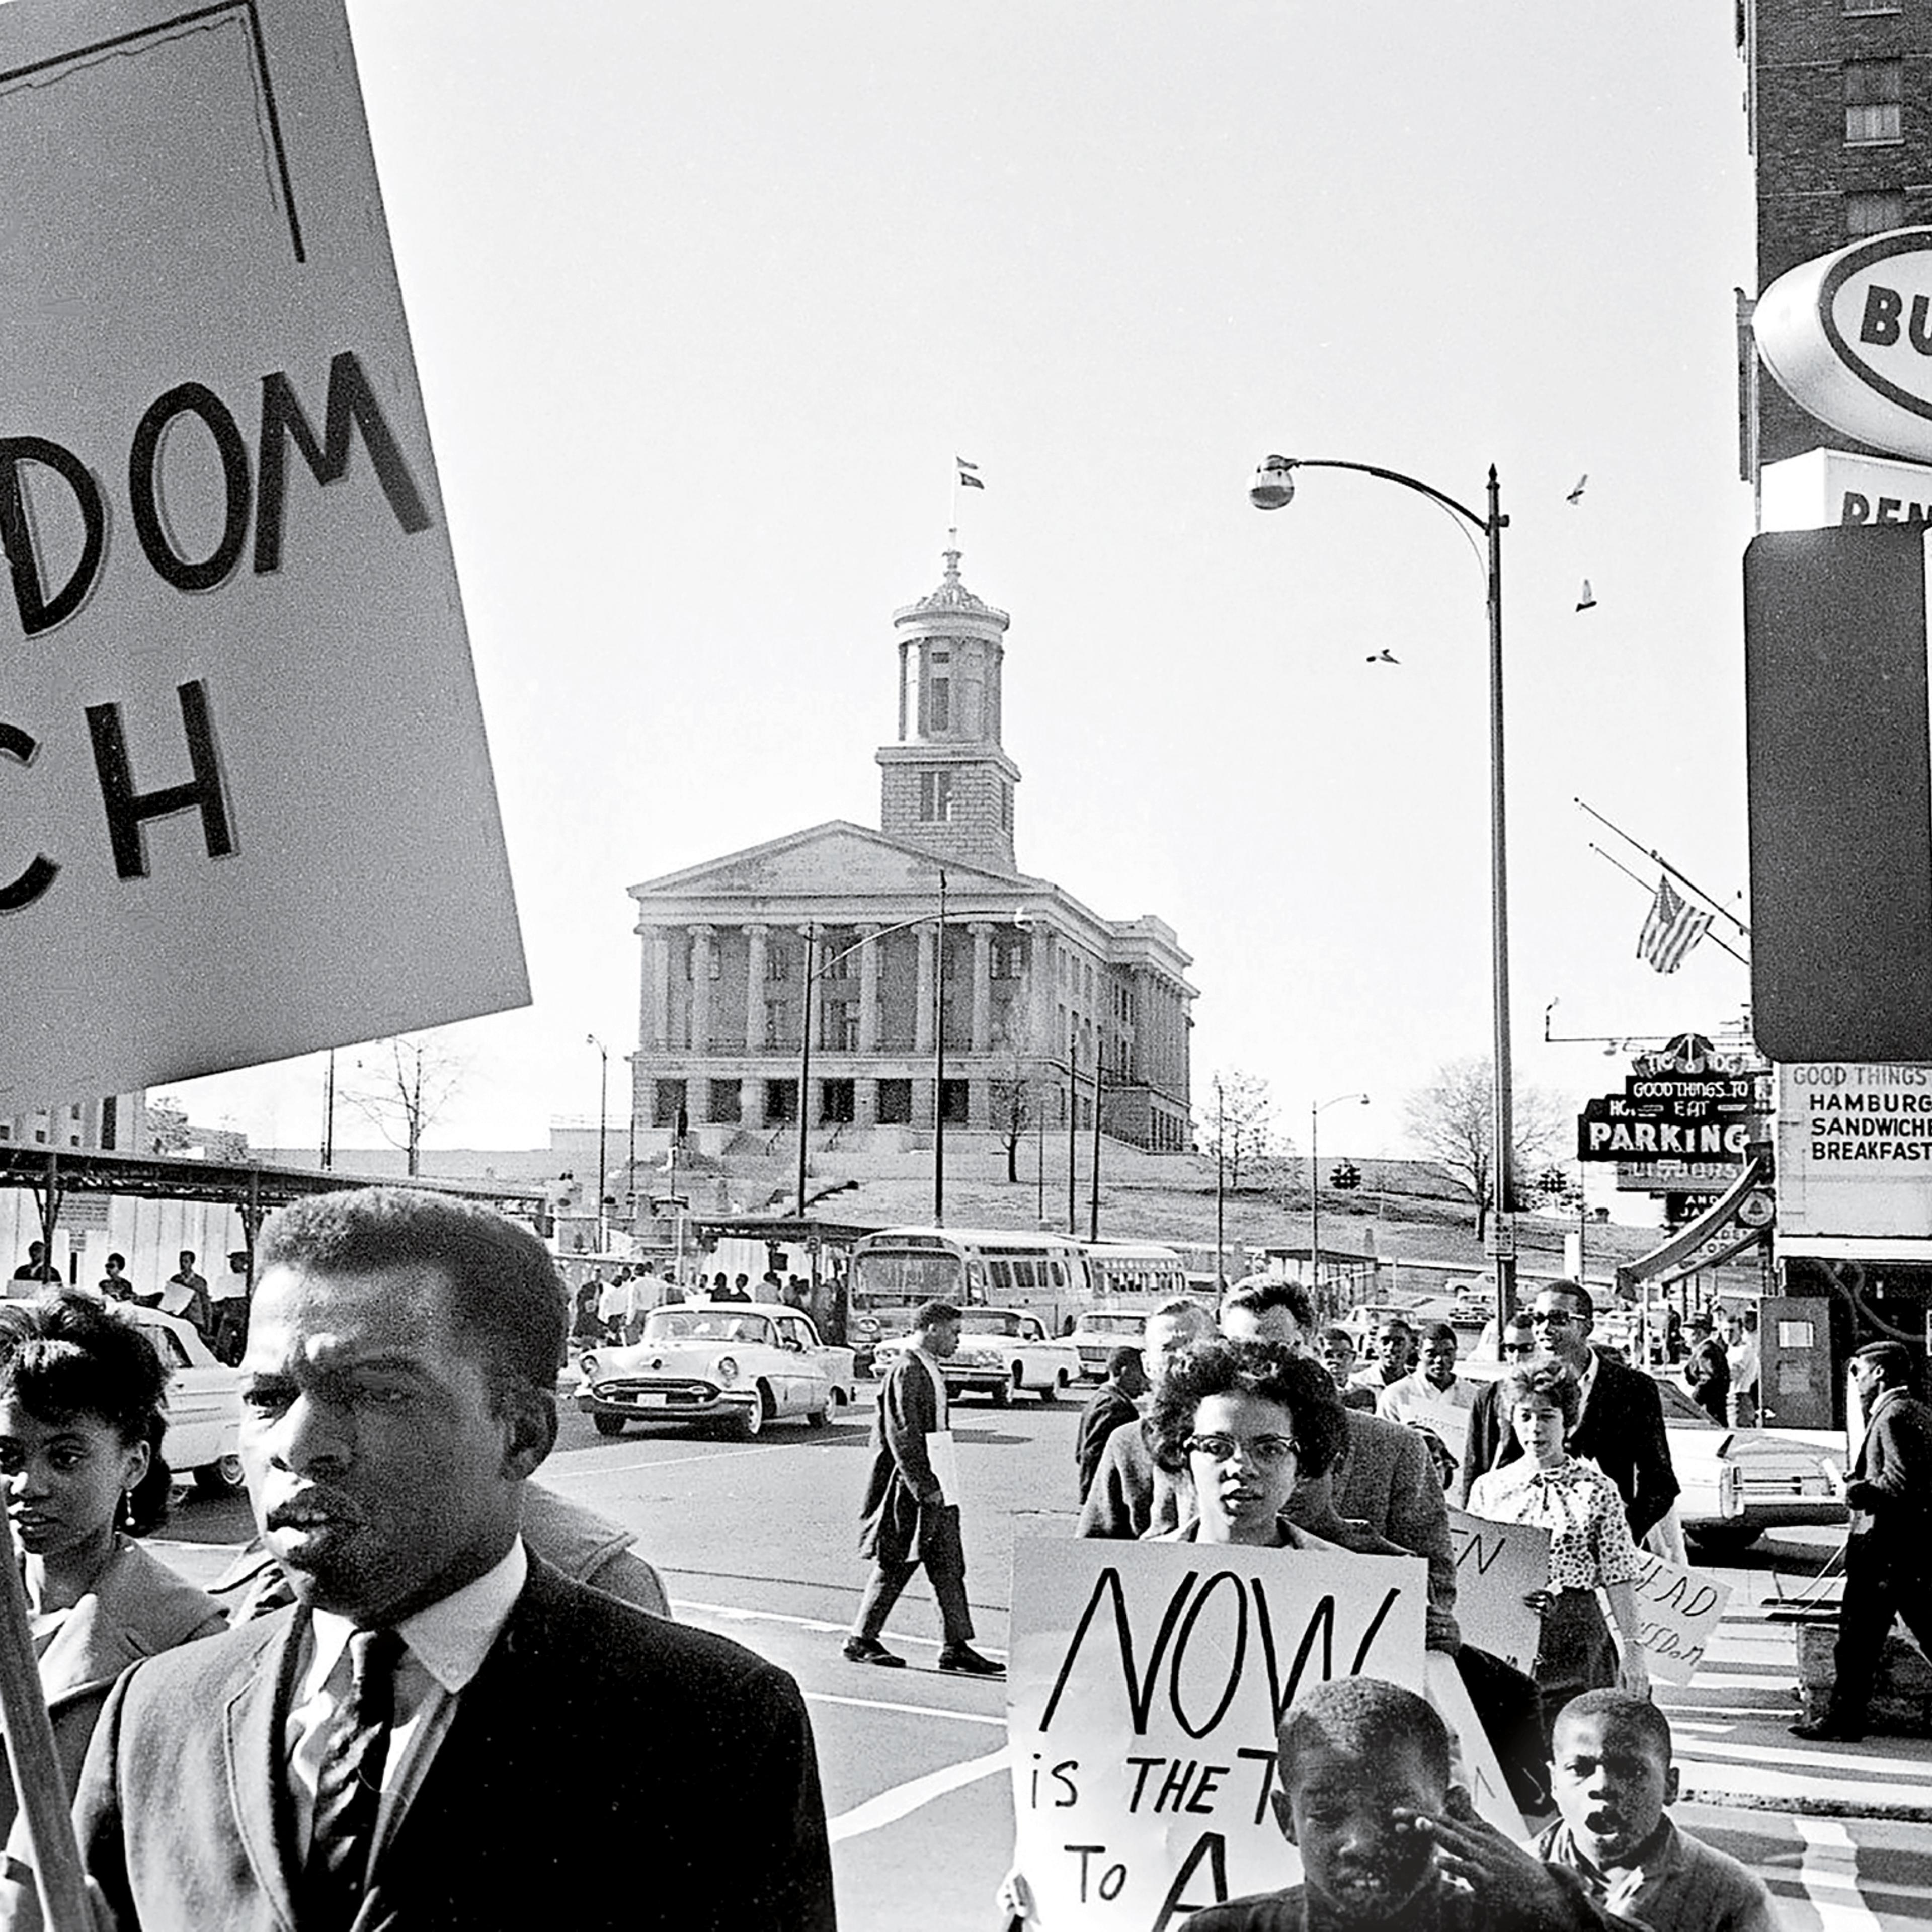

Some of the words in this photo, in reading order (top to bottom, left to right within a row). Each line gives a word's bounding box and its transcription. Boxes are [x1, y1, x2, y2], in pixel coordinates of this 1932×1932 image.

[1794, 1066, 1847, 1086] GOOD
[1854, 1065, 1927, 1086] THINGS
[1633, 1082, 1673, 1098] GOOD
[1672, 1082, 1725, 1098] THINGS
[1730, 1081, 1748, 1098] TO
[1673, 1100, 1710, 1117] EAT
[1589, 1122, 1751, 1154] PARKING
[1812, 1141, 1932, 1160] BREAKFAST
[1039, 1567, 1401, 1739] NOW
[1127, 1758, 1231, 1813] THE
